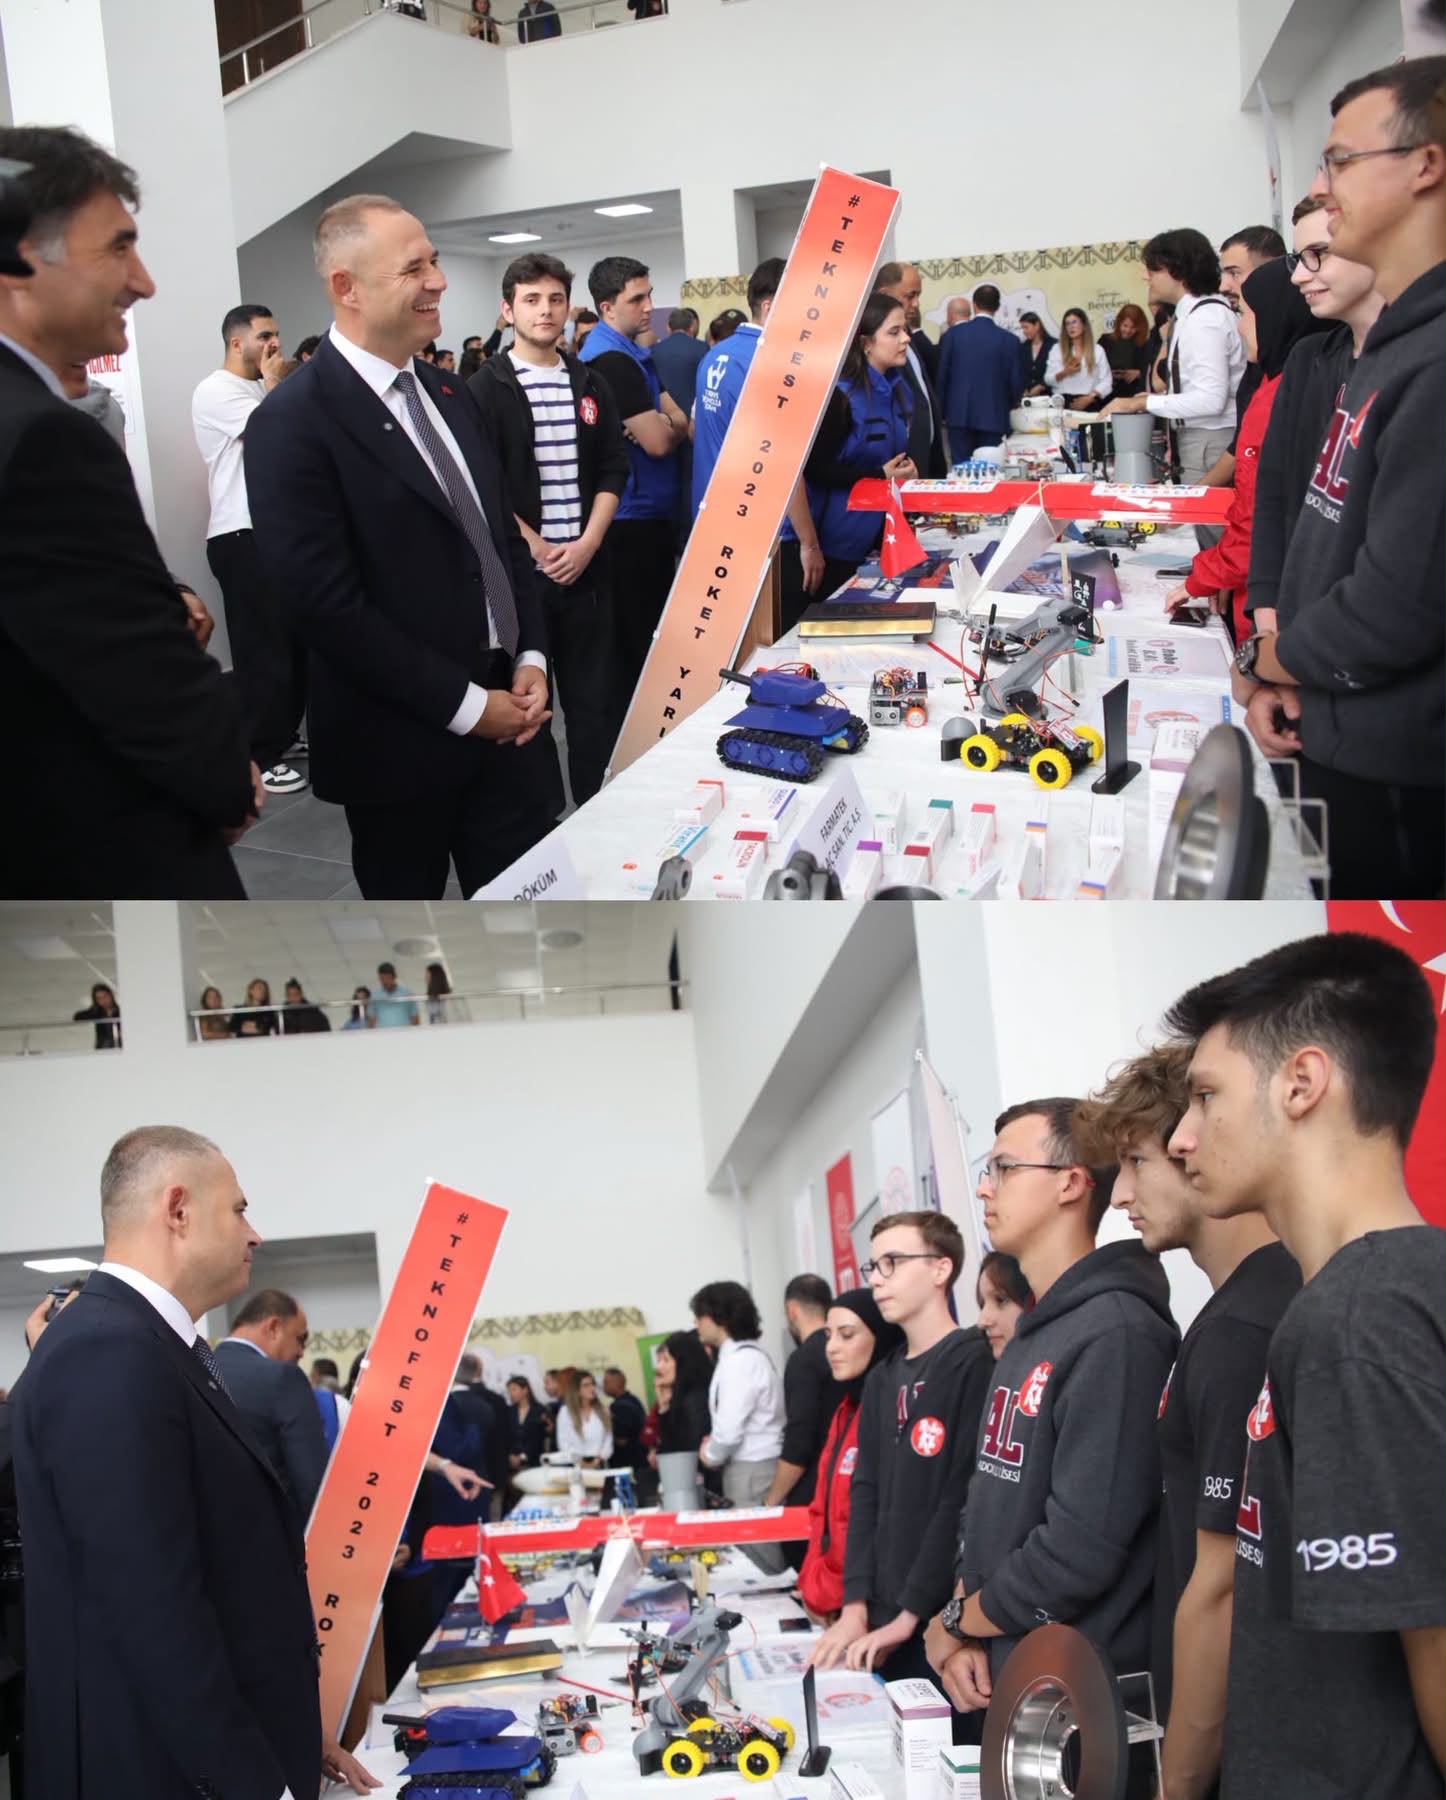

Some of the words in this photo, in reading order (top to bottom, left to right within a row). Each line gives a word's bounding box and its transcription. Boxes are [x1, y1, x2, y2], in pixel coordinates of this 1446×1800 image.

[777, 194, 861, 409] #TEKNOFEST
[736, 440, 772, 517] 2023
[694, 545, 734, 639] ROKET
[820, 796, 847, 843] FARMATEK
[384, 1212, 469, 1437] #TEKNOFEST
[342, 1472, 379, 1559] 2023
[1203, 1476, 1234, 1499] 985
[1296, 1533, 1397, 1571] 1985
